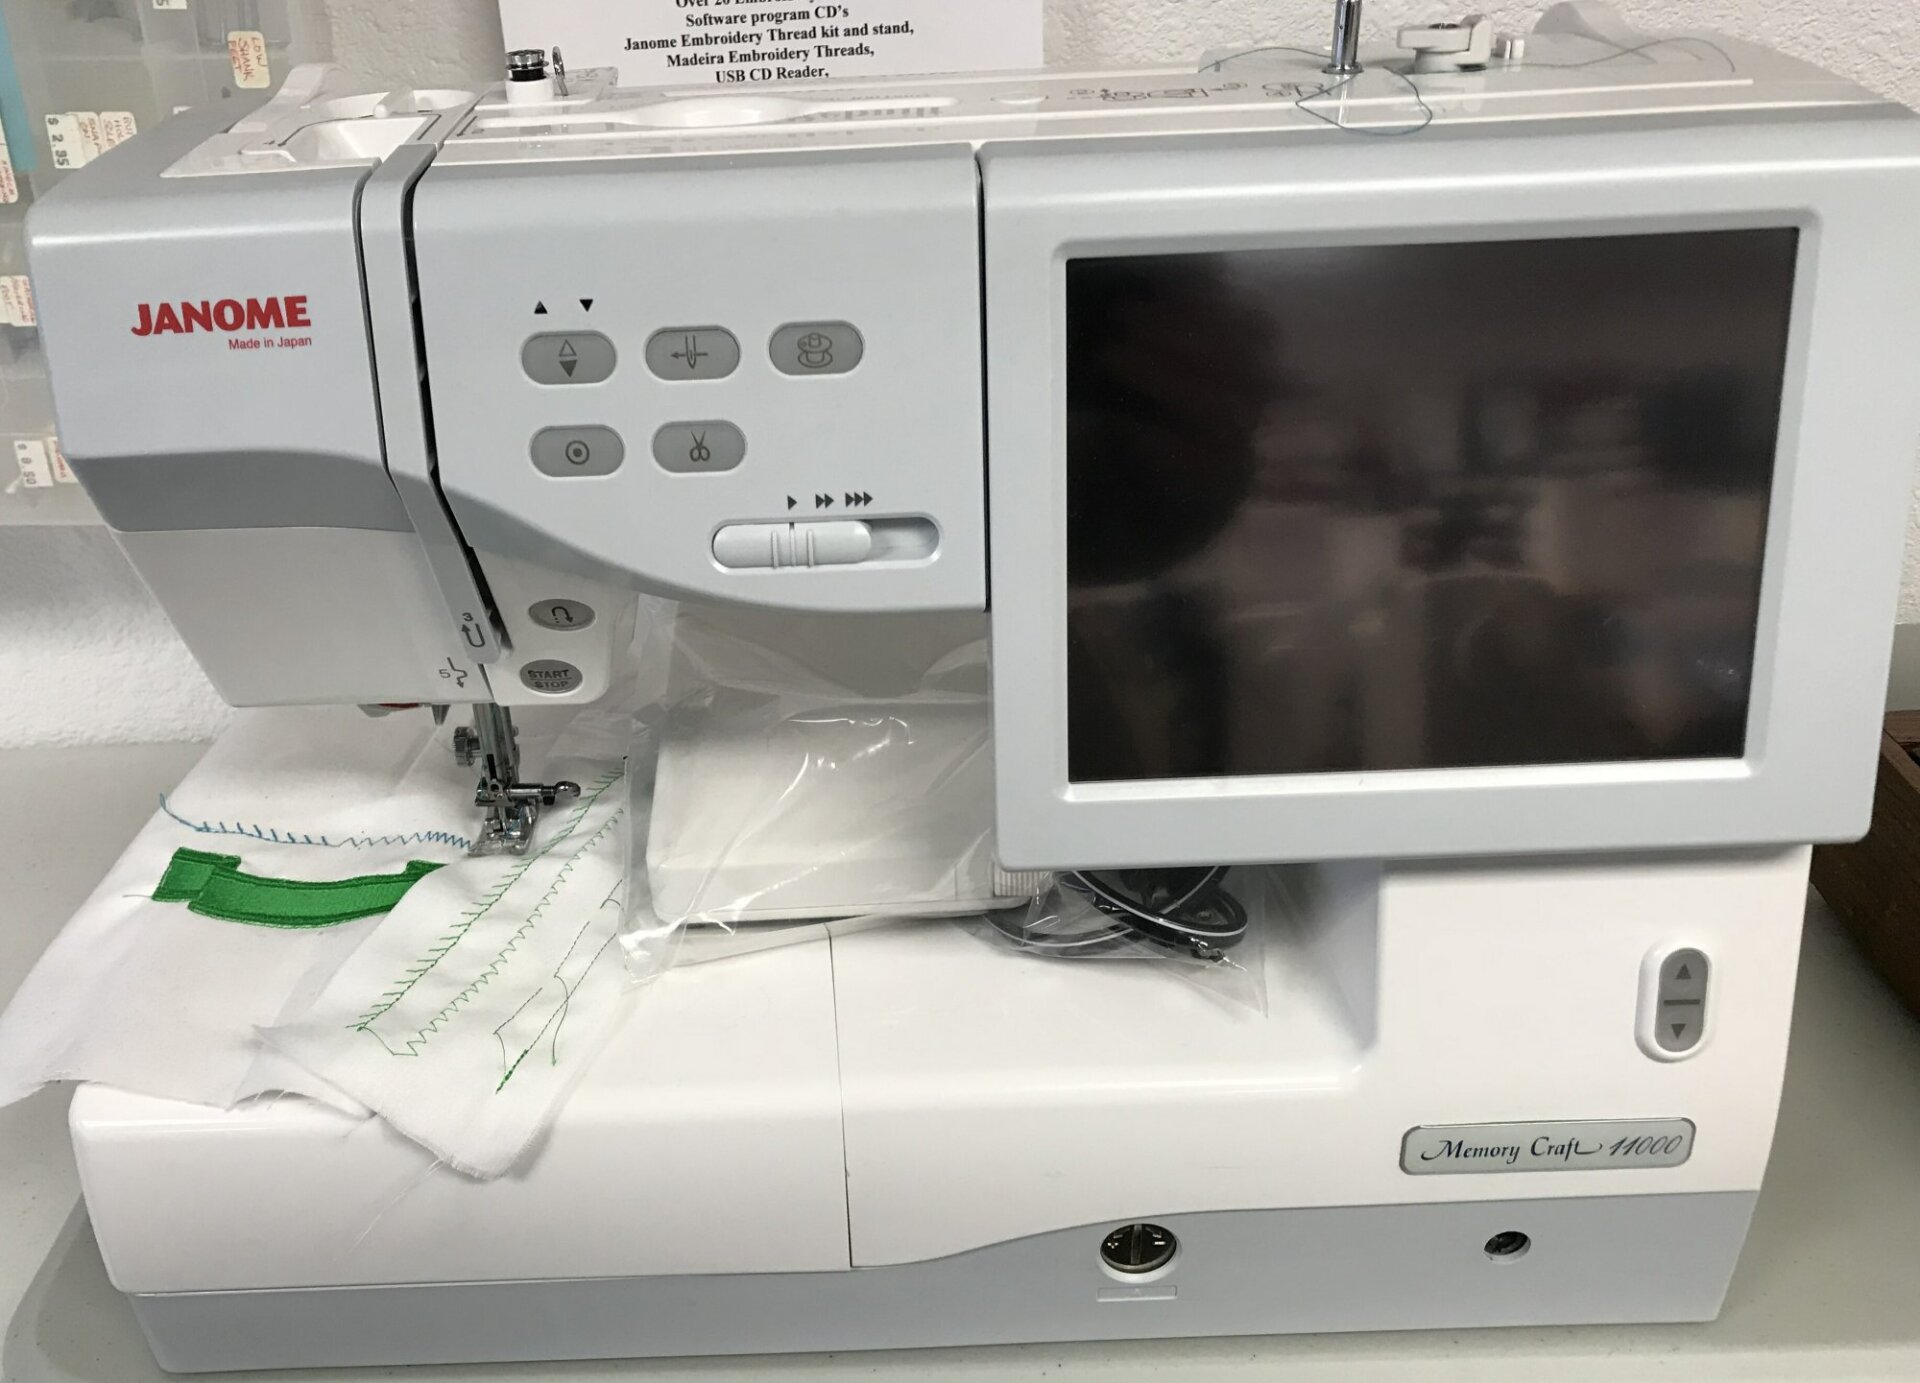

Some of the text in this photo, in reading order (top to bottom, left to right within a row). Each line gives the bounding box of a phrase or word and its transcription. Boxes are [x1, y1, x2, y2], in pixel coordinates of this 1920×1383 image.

[685, 5, 849, 27] Software program CD's
[624, 21, 914, 50] Janome Embroidery Thread kit and stand,
[667, 43, 875, 67] Madeira Embroidery Threads,
[715, 65, 829, 83] USB CD Reader,
[131, 295, 311, 336] JANOME
[229, 336, 312, 350] Made in Japan
[462, 612, 473, 622] 3
[438, 668, 451, 679] 5
[527, 669, 570, 680] START
[534, 680, 569, 689] STOP
[1421, 1135, 1684, 1165] Memory Craft 11000
